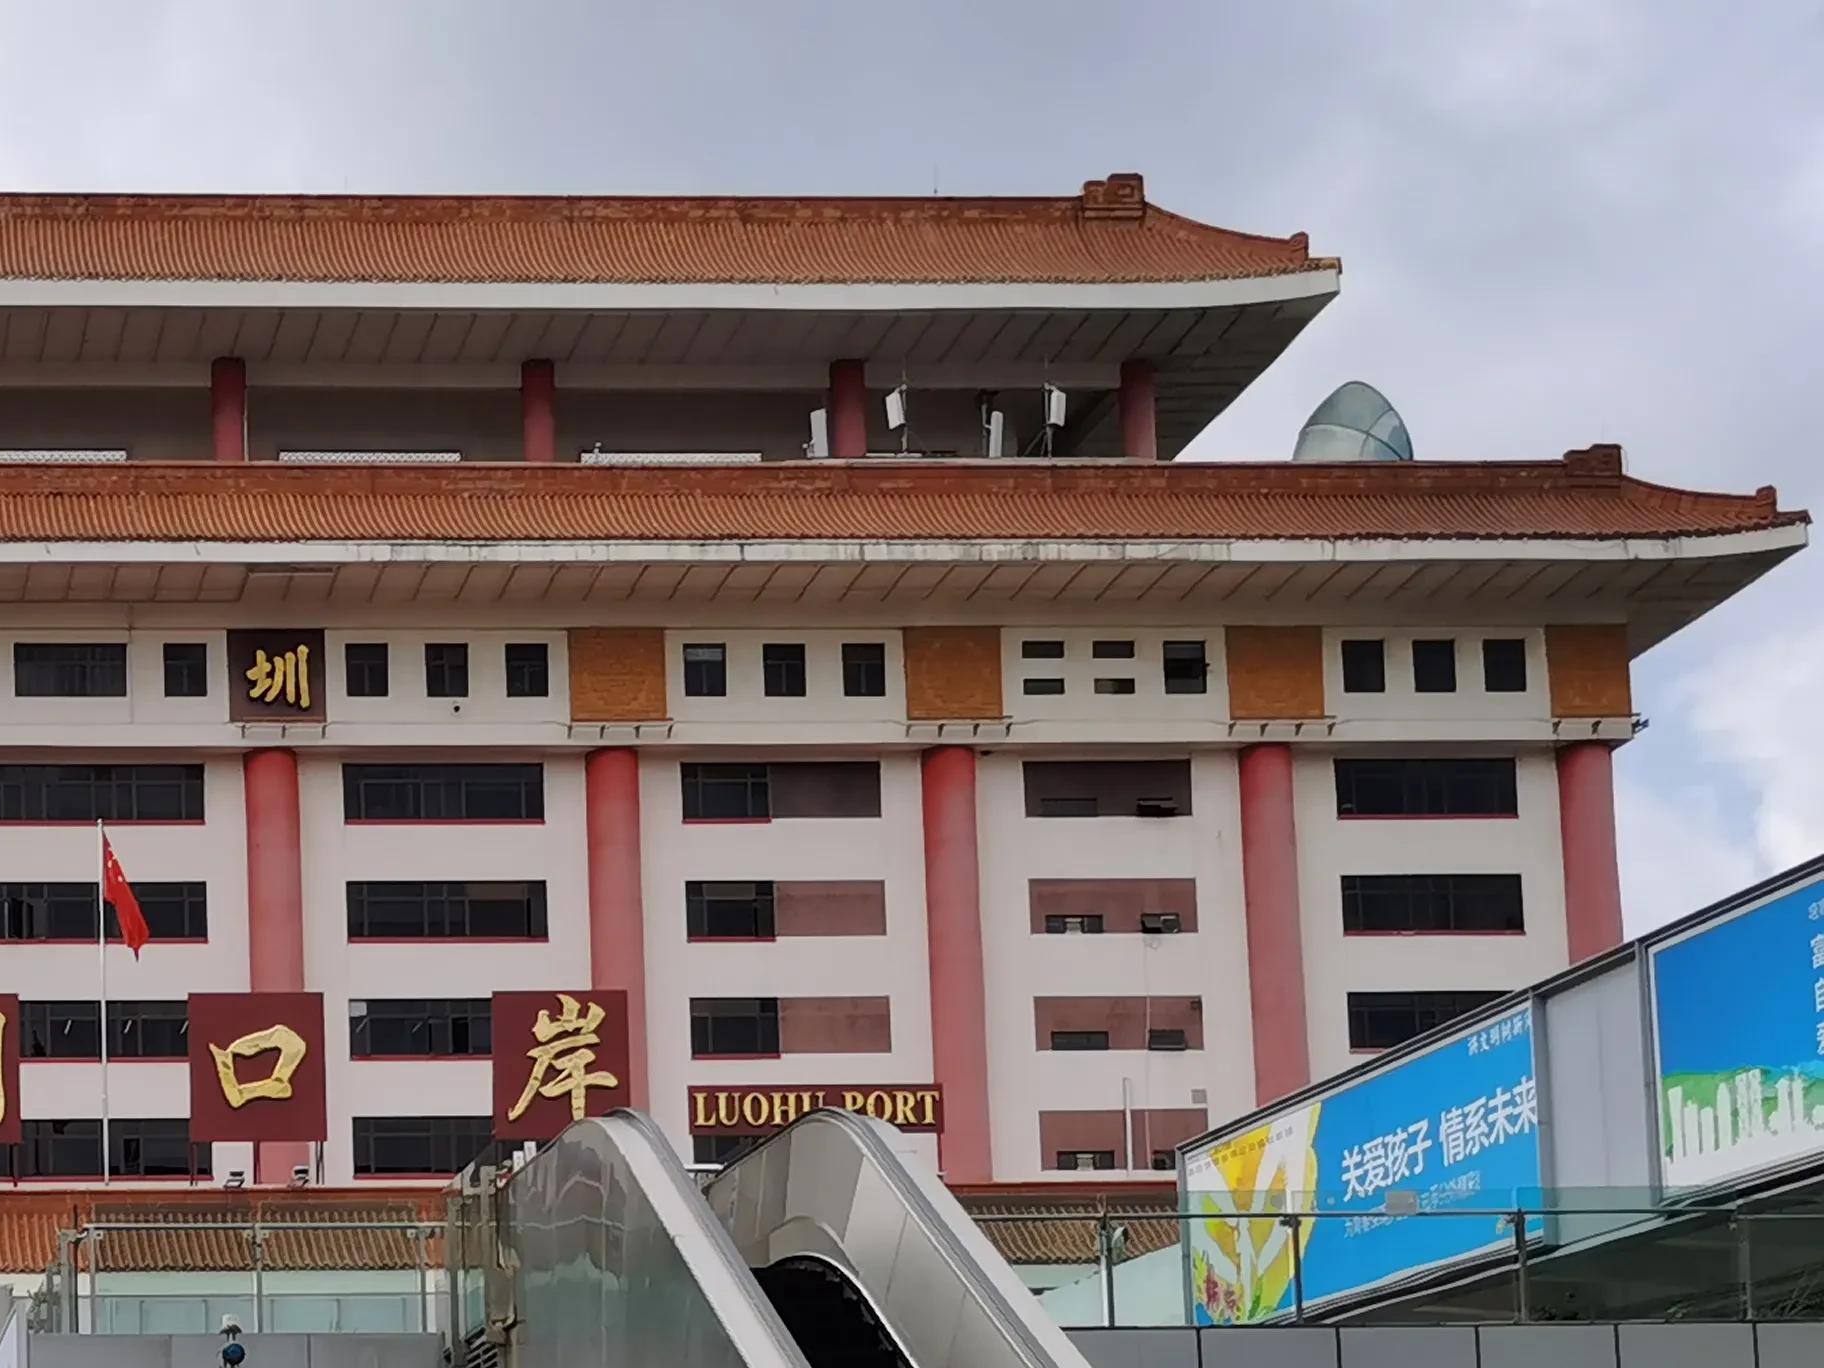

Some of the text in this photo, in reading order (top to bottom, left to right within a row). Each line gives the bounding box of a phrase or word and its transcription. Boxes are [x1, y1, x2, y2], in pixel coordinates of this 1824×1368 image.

[841, 1091, 941, 1126] PORT
[1341, 1118, 1433, 1202] 关爱孩子
[1438, 1074, 1539, 1168] 情系未来
